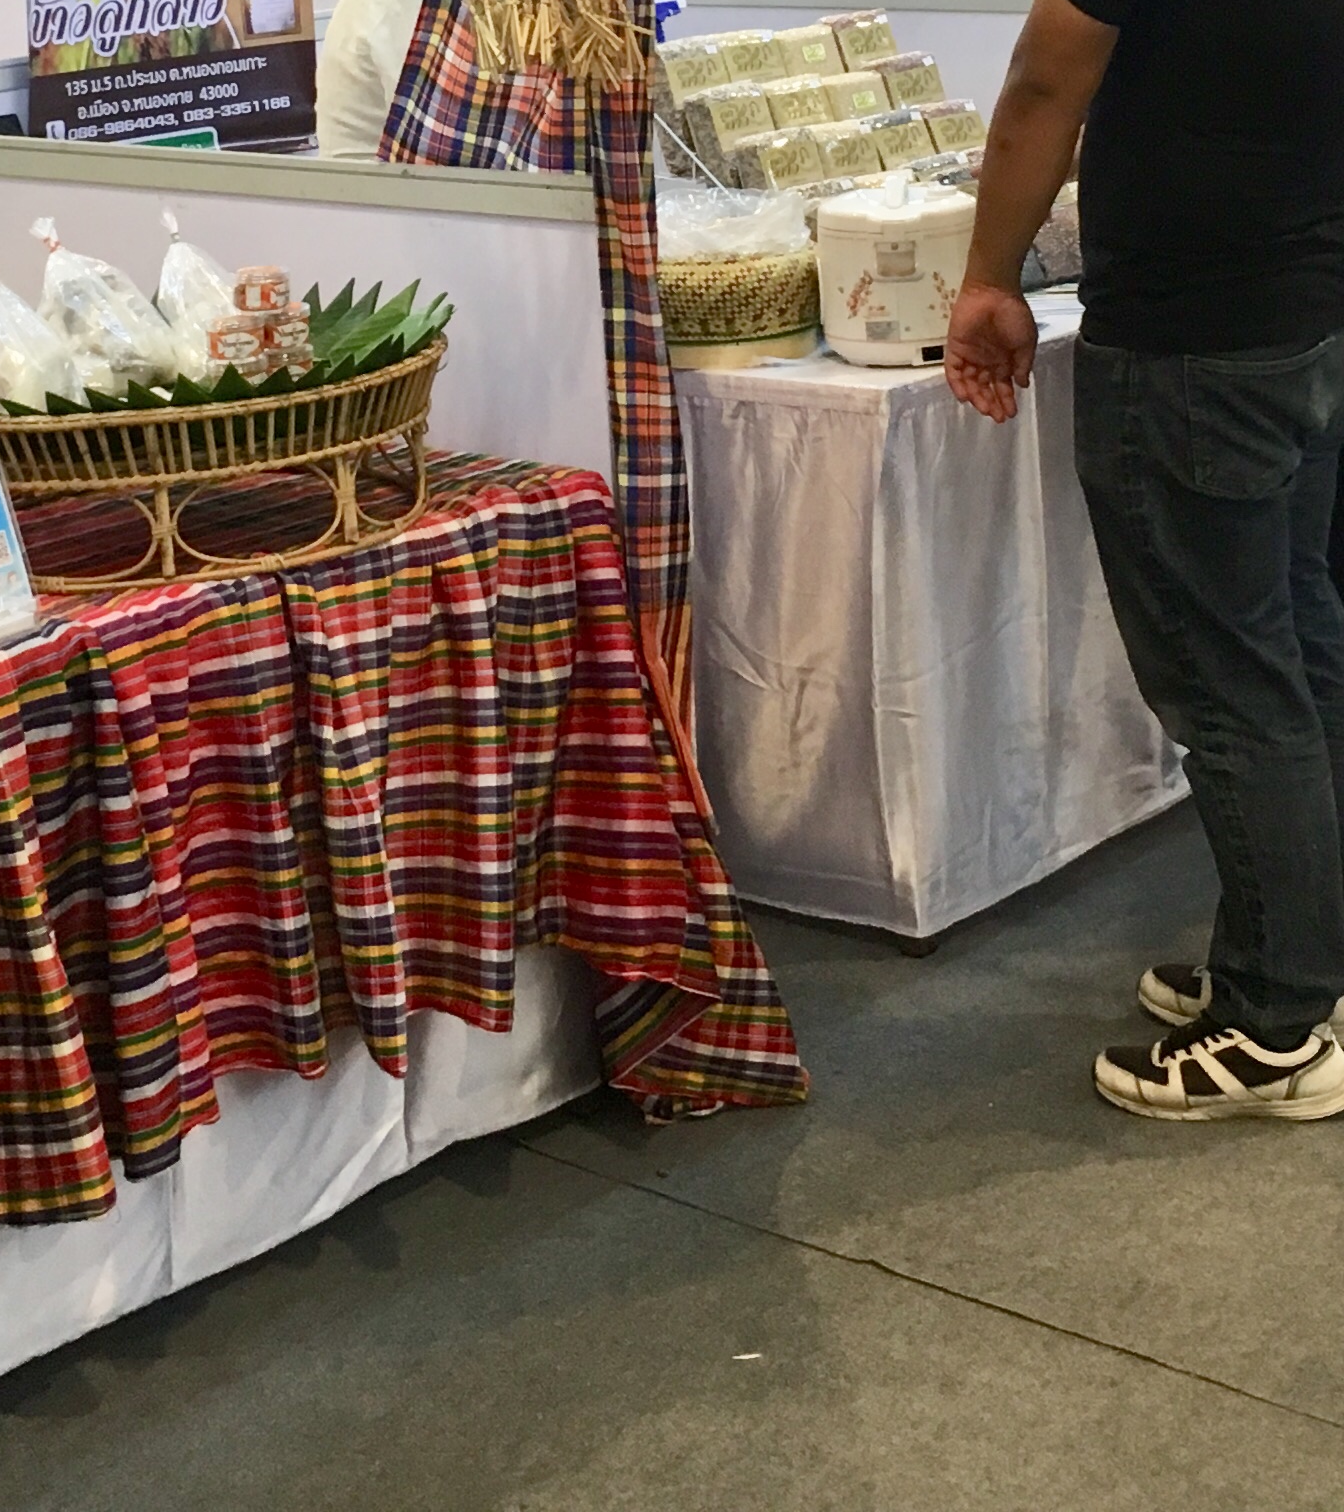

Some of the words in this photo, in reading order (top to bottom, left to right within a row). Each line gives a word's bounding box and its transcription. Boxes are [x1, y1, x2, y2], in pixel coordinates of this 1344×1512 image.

[65, 79, 88, 97] 135
[91, 78, 111, 93] ม.5
[169, 56, 267, 82] ต.หนองกอมเกาะ
[78, 99, 119, 120] อ.เมือง
[122, 90, 193, 114] จ.หนองคาย
[199, 83, 238, 100] 43000
